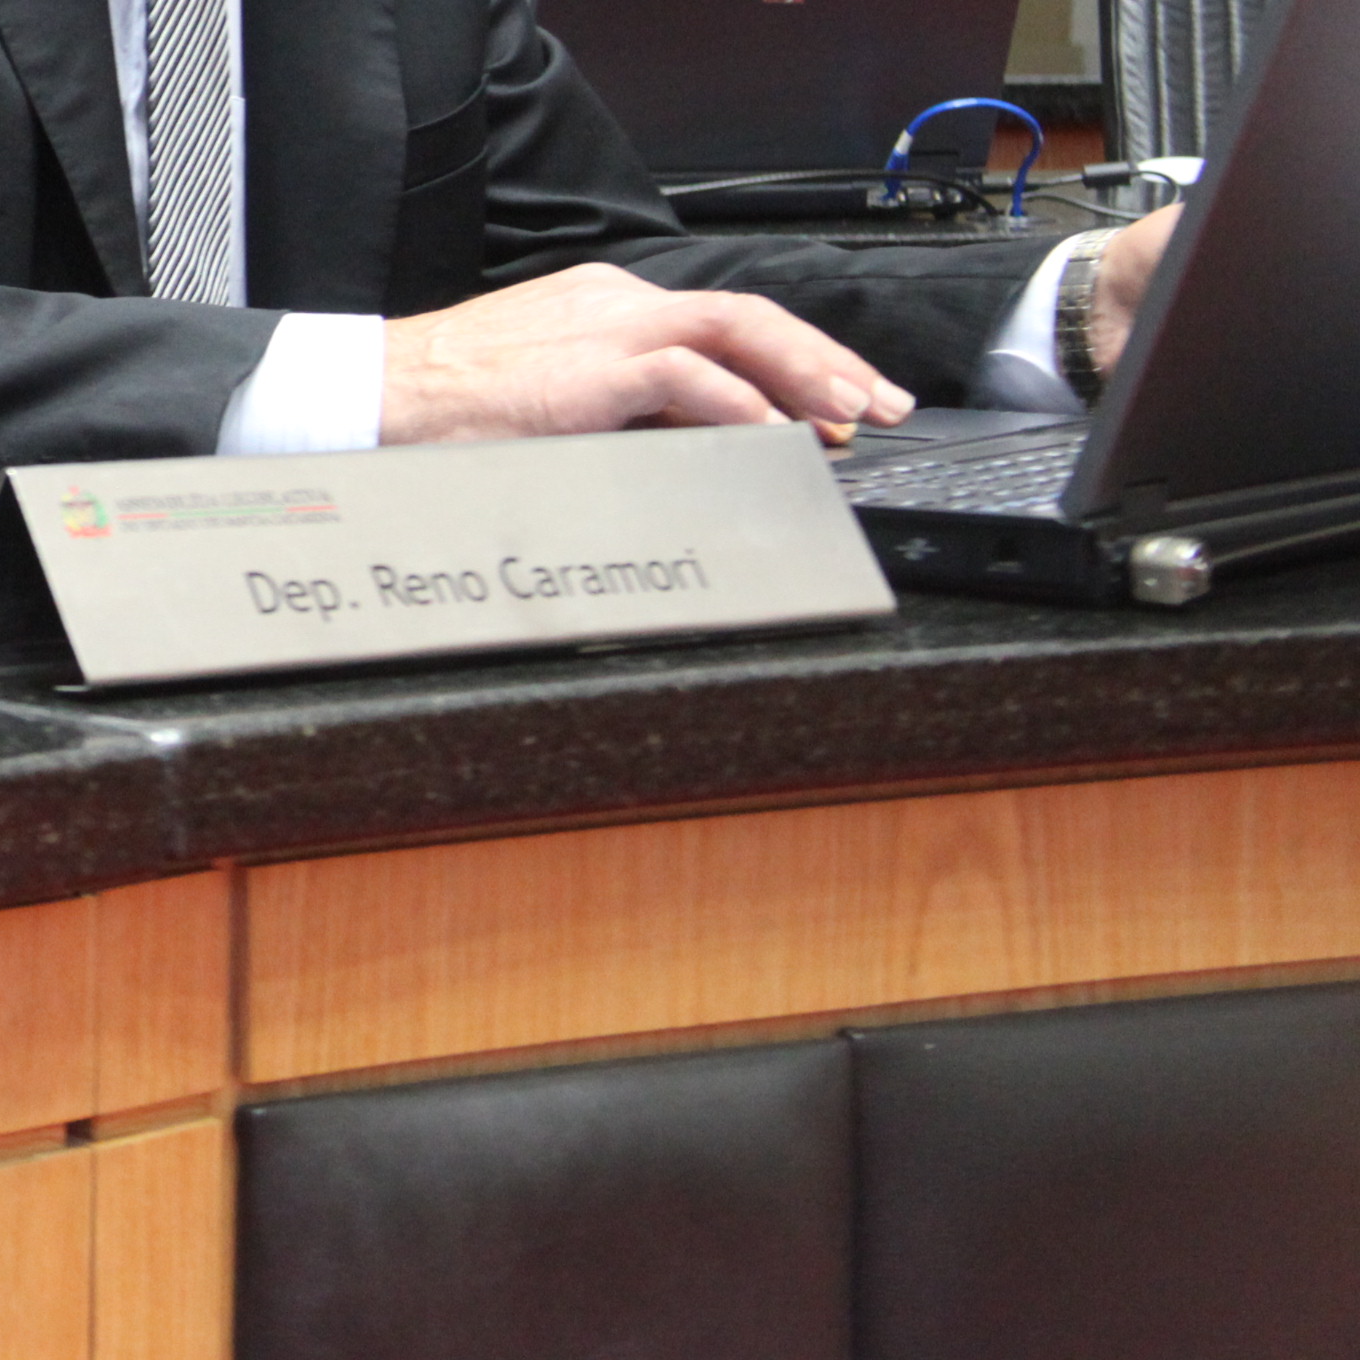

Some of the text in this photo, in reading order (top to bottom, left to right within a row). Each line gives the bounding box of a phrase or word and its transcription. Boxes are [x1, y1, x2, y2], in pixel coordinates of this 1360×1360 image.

[245, 547, 710, 623] Dep. Reno Caramori
